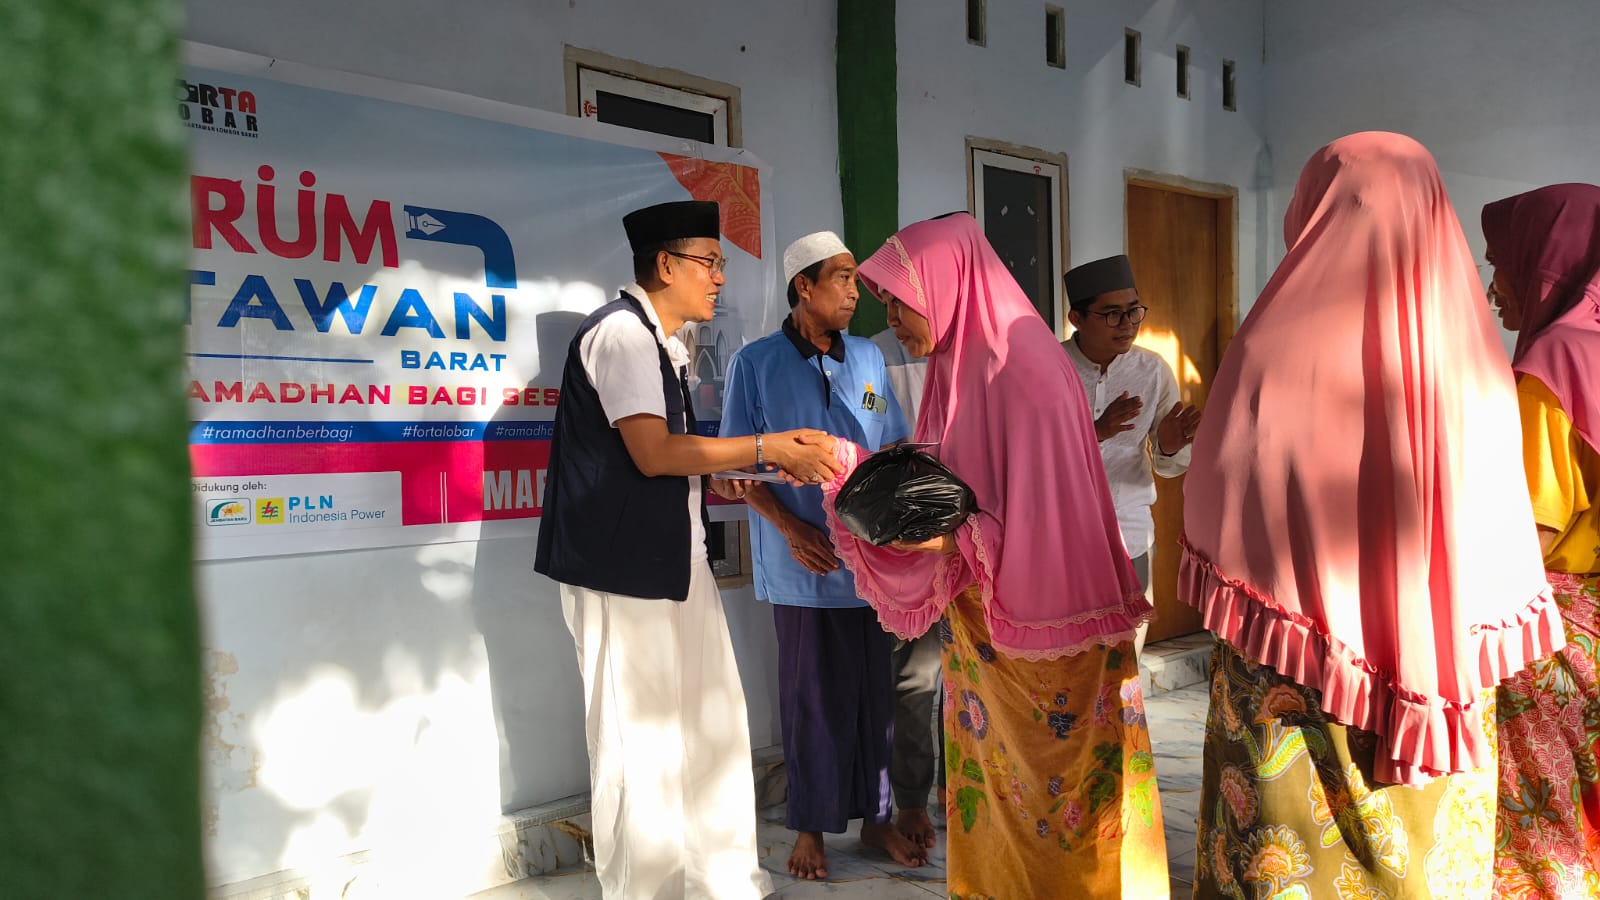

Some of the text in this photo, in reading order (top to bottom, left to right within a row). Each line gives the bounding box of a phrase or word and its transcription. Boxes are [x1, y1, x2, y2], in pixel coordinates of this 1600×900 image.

[401, 350, 506, 371] BARAT
[408, 386, 487, 405] BAGI
[202, 425, 353, 442] #ramadhanberbagi
[402, 425, 475, 438] #fortalobar
[242, 481, 267, 491] oleh:
[289, 495, 333, 510] PLN
[289, 508, 386, 523] Indonesia Power
